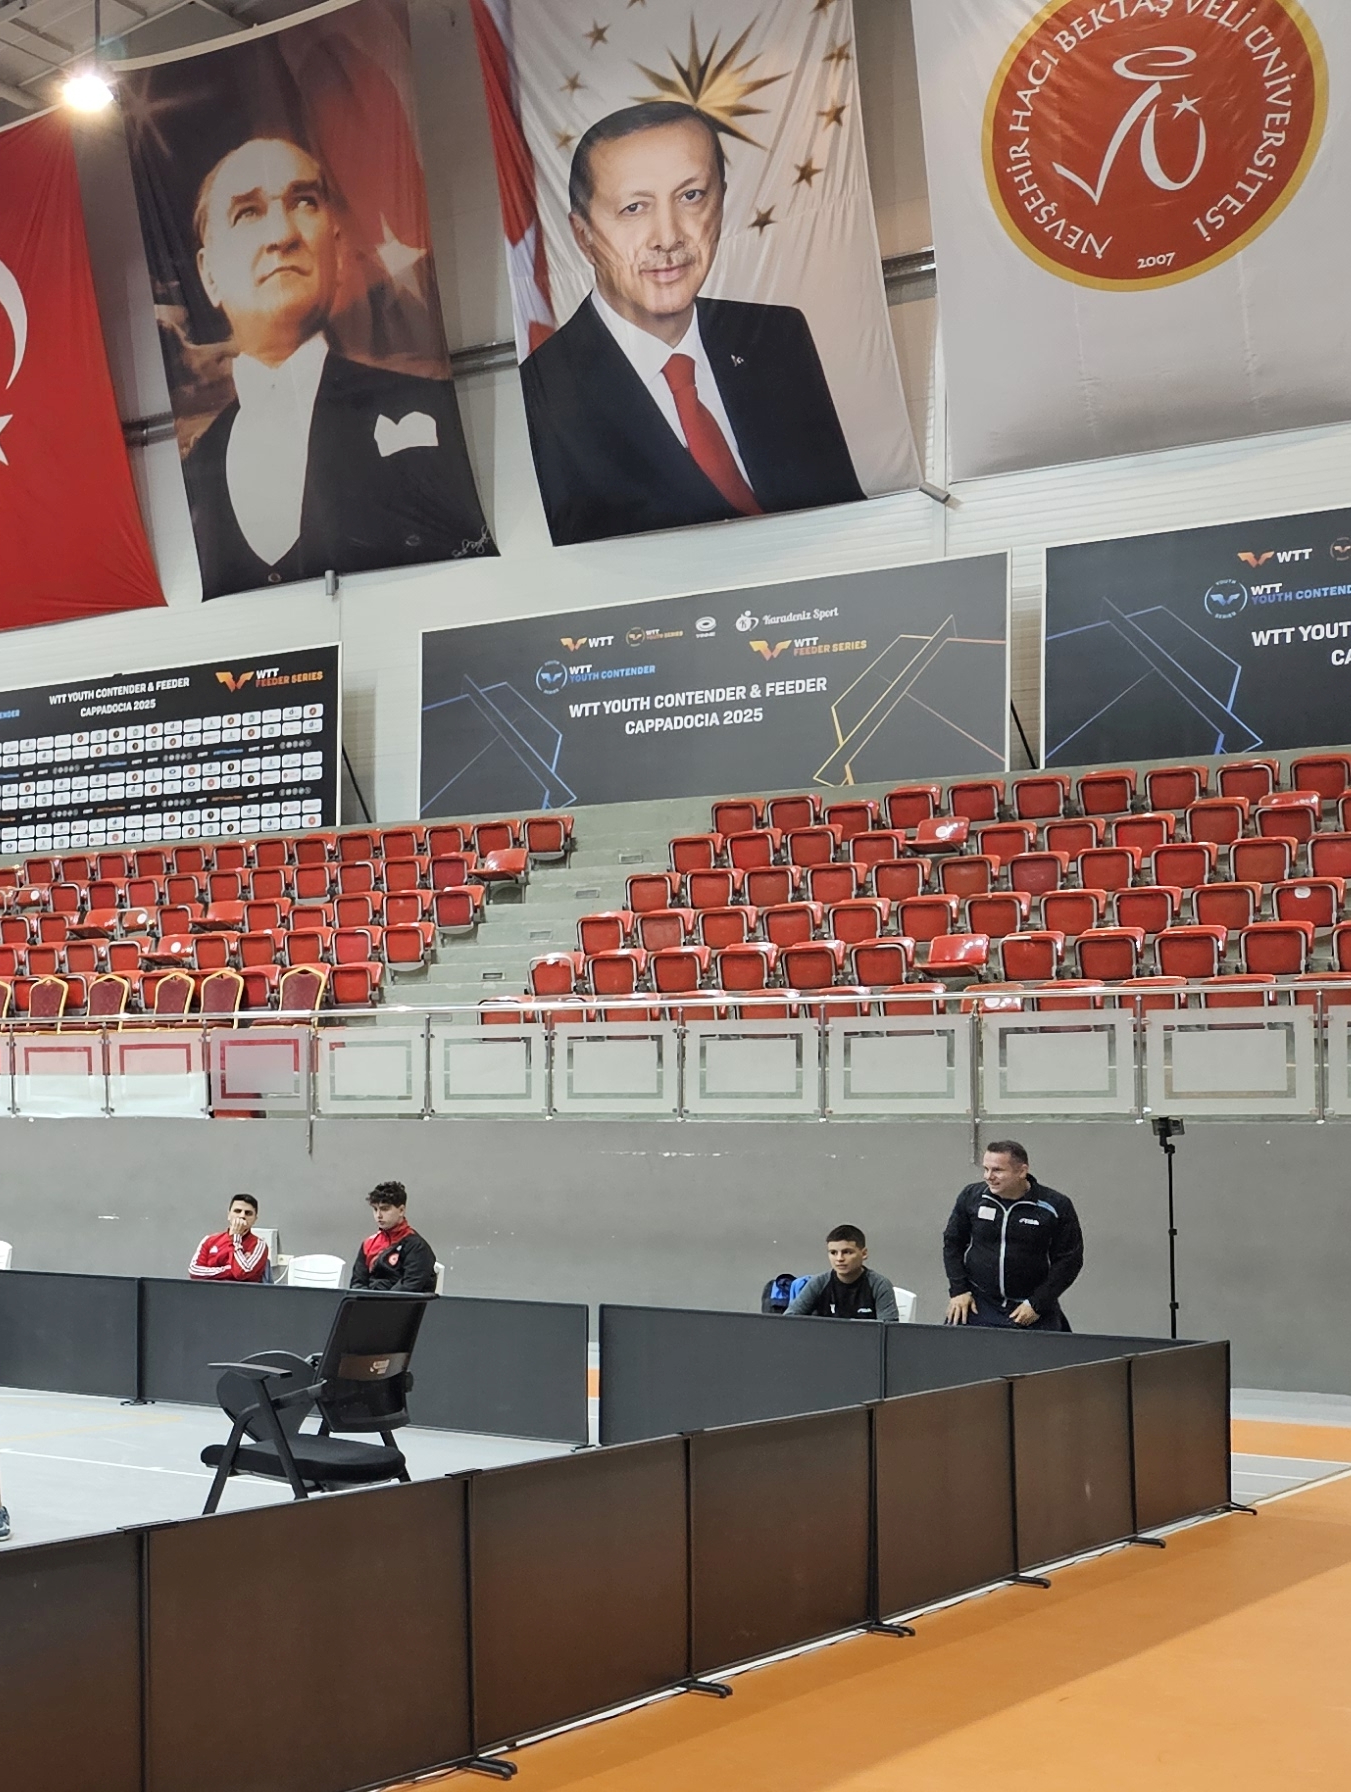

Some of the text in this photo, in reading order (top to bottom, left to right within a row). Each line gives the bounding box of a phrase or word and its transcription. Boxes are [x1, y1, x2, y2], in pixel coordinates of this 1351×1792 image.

[1009, 49, 1060, 132] HACI
[1192, 24, 1297, 242] ÜNİVERSİTESİ
[1006, 137, 1113, 259] NEVŞEHİR
[1136, 251, 1176, 270] 2007
[1276, 548, 1313, 564] WTT
[1250, 582, 1283, 596] WTT
[1251, 591, 1293, 606] YOUTH
[762, 607, 839, 625] Karadeniz Sport
[588, 636, 615, 649] WTT
[793, 636, 819, 648] WTT
[1251, 627, 1295, 647] WTT
[793, 640, 867, 657] FEEDER SERIES
[256, 667, 280, 680] WTT
[569, 664, 593, 675] WTT
[569, 665, 656, 683] YOUTH CONTENDER
[255, 671, 324, 688] FEEDER SERIES
[48, 677, 190, 705] WTT YOUTH CONTENDER & FEEDER
[568, 676, 828, 718] WTT YOUTH CONTENDER & FEEDER
[80, 699, 157, 717] CAPPADOCIA 2025
[625, 707, 763, 735] CAPPADOCIA 2025
